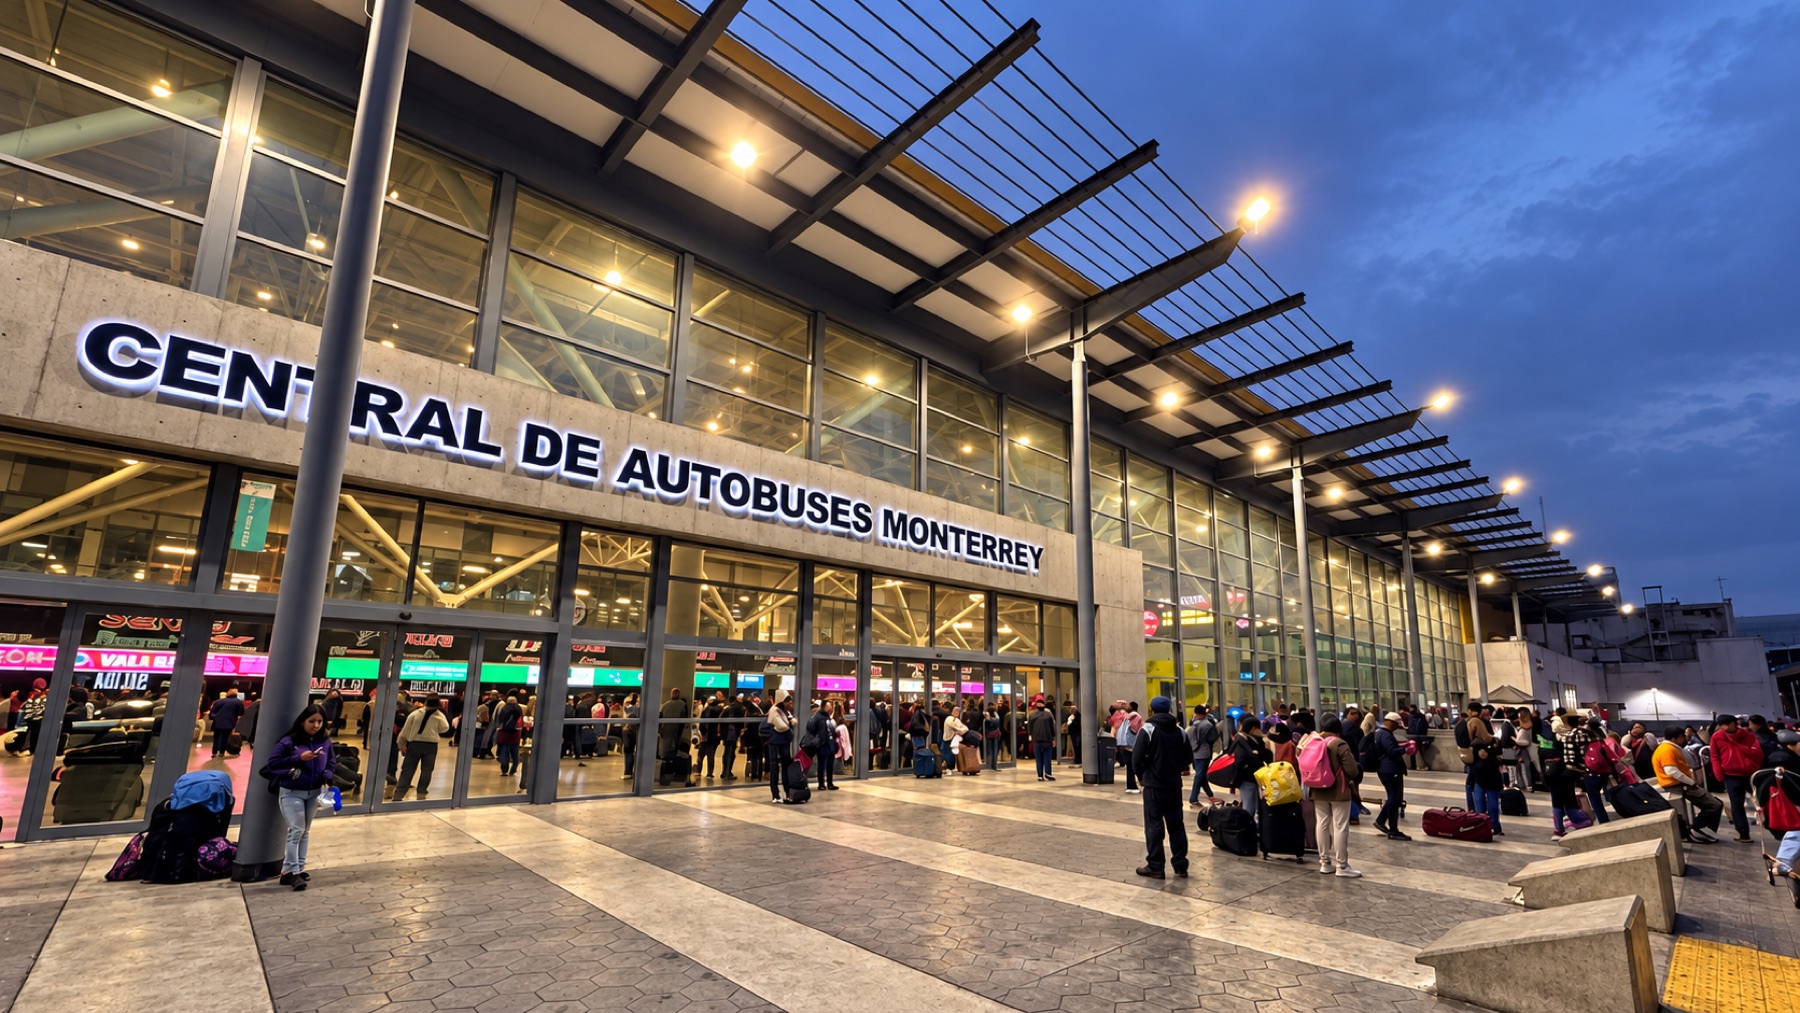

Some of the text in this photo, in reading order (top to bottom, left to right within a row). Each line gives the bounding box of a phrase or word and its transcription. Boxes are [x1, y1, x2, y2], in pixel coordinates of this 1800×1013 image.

[521, 422, 601, 478] DE
[615, 447, 873, 535] AUTOBUSES
[882, 509, 1045, 570] MONTERREY
